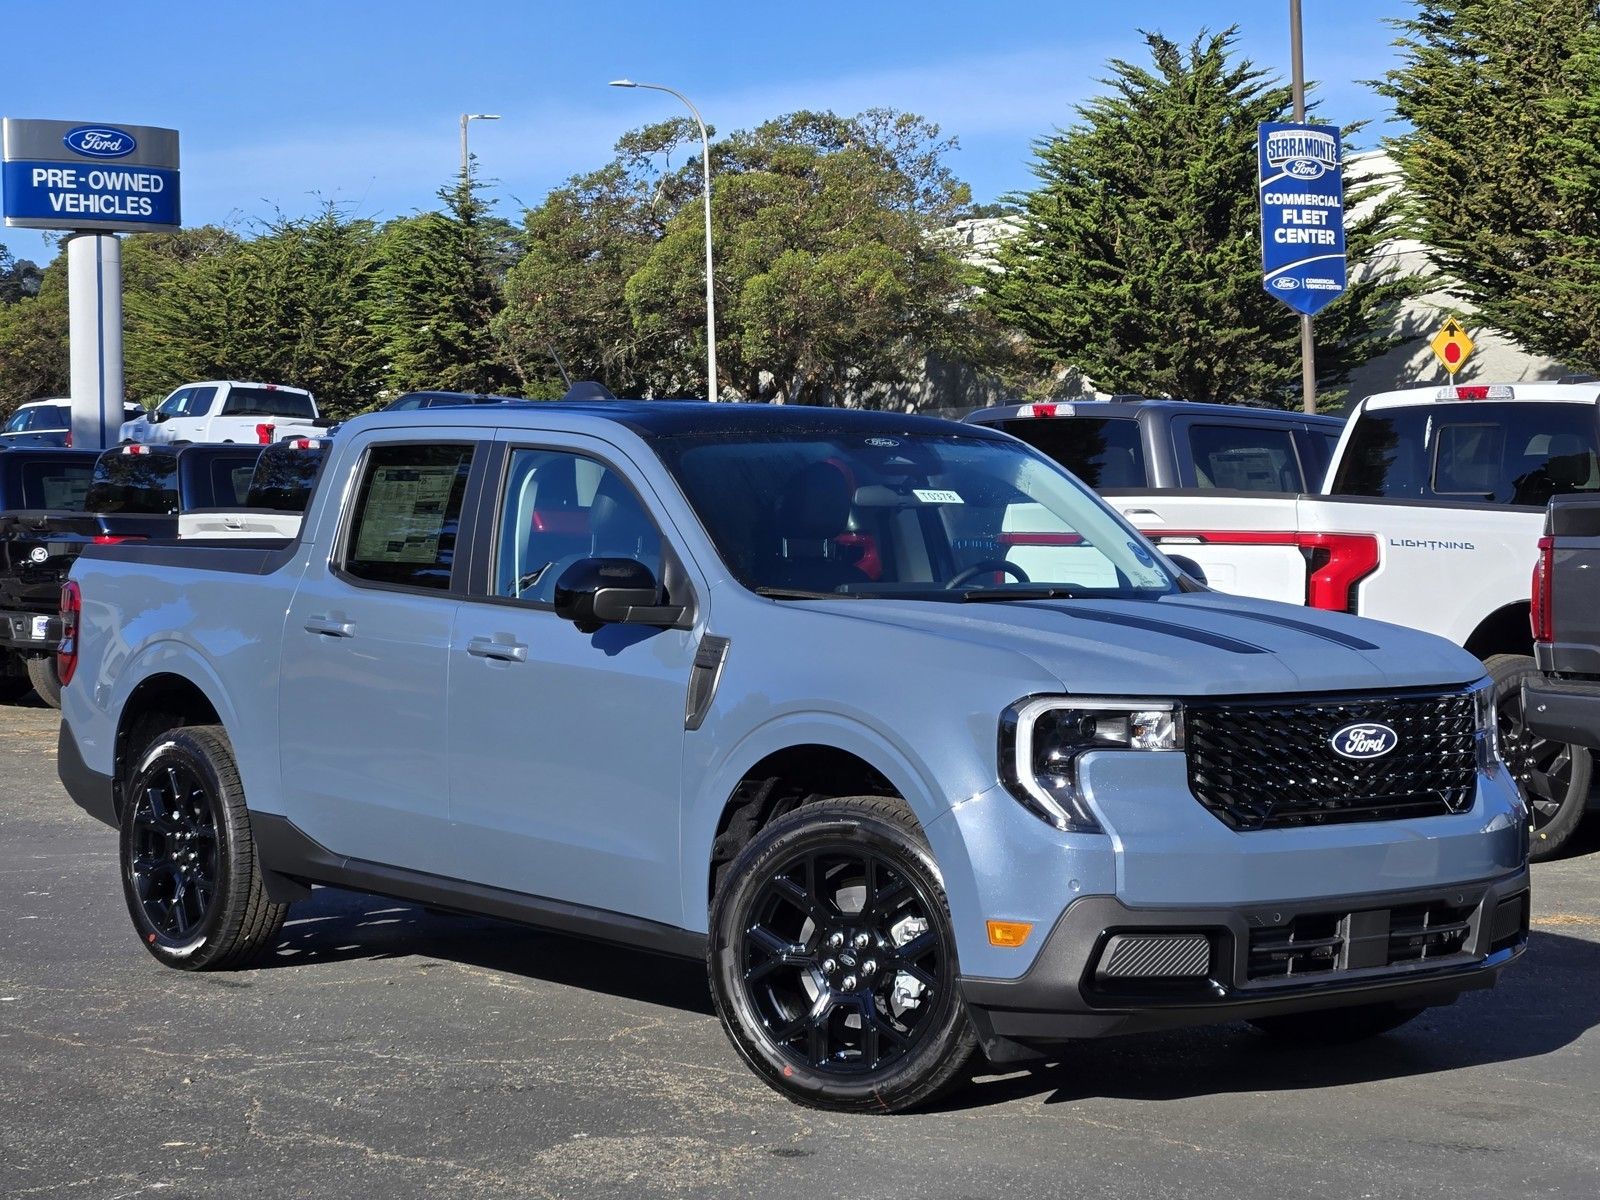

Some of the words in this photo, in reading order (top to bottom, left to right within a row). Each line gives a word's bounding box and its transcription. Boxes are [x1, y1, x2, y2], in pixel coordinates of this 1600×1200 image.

[81, 132, 121, 151] Ford
[1268, 137, 1335, 162] SERRAMONTE
[1292, 160, 1317, 175] Ford
[32, 168, 164, 193] PRE-OWNED
[49, 192, 152, 216] VEHICLES
[1264, 193, 1341, 208] COMMERCIAL
[1282, 209, 1328, 225] FLEET
[1274, 228, 1335, 245] CENTER
[920, 492, 956, 502] T0378
[1390, 538, 1475, 550] LIGHTNING
[1345, 728, 1386, 753] Ford
